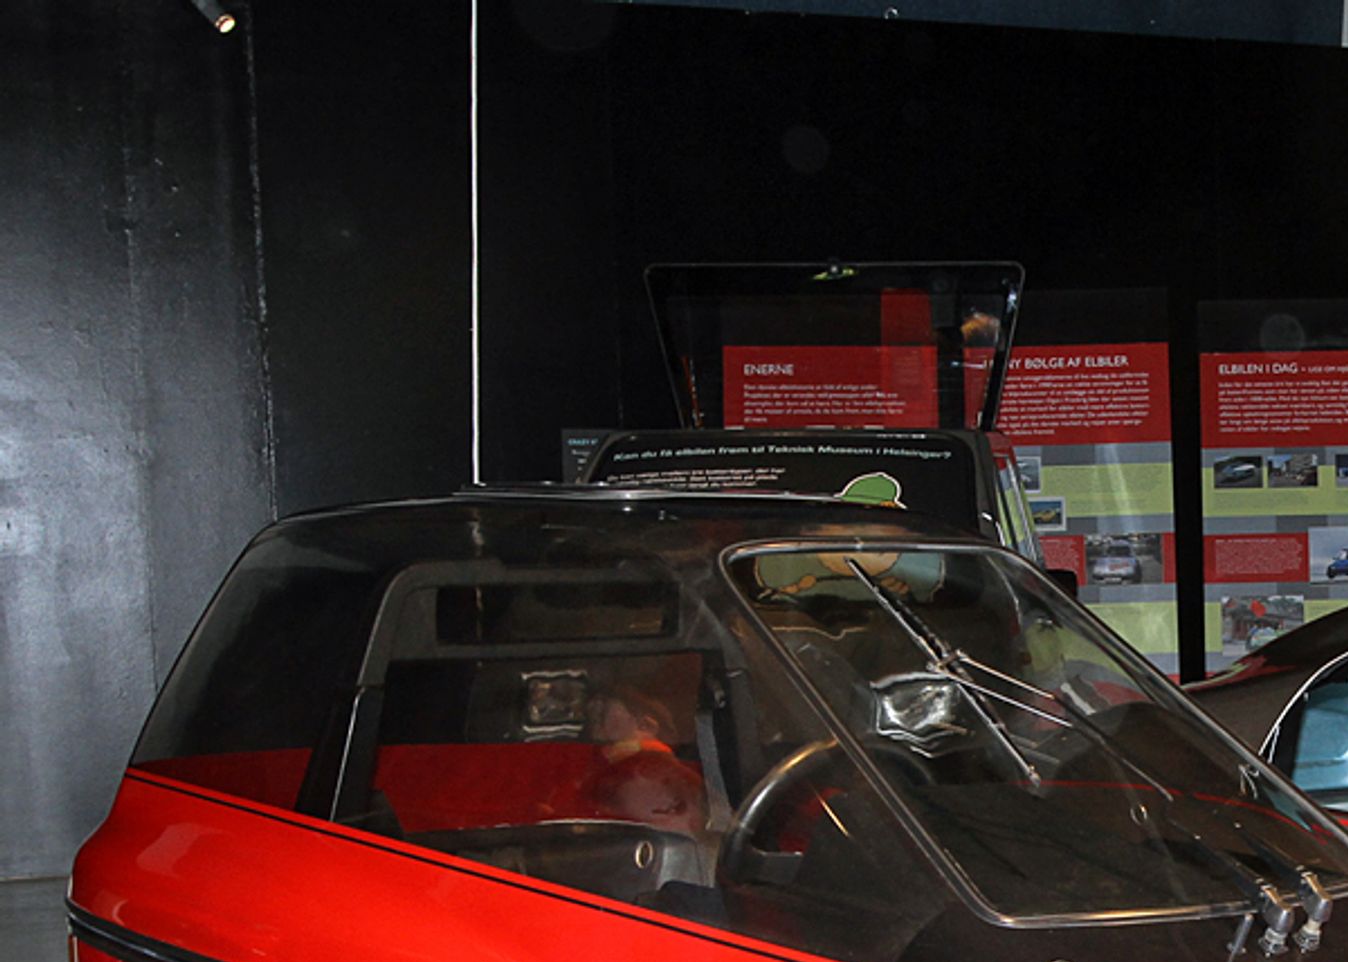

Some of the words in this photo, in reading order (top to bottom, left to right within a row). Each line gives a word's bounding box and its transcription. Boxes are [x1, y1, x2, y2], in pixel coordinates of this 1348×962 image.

[1024, 357, 1065, 369] BØLGE
[1067, 357, 1082, 368] AF
[1084, 354, 1129, 368] ELBILER
[743, 364, 795, 376] ENERNE
[1218, 363, 1264, 375] ELBILEN
[1272, 362, 1298, 374] DAG
